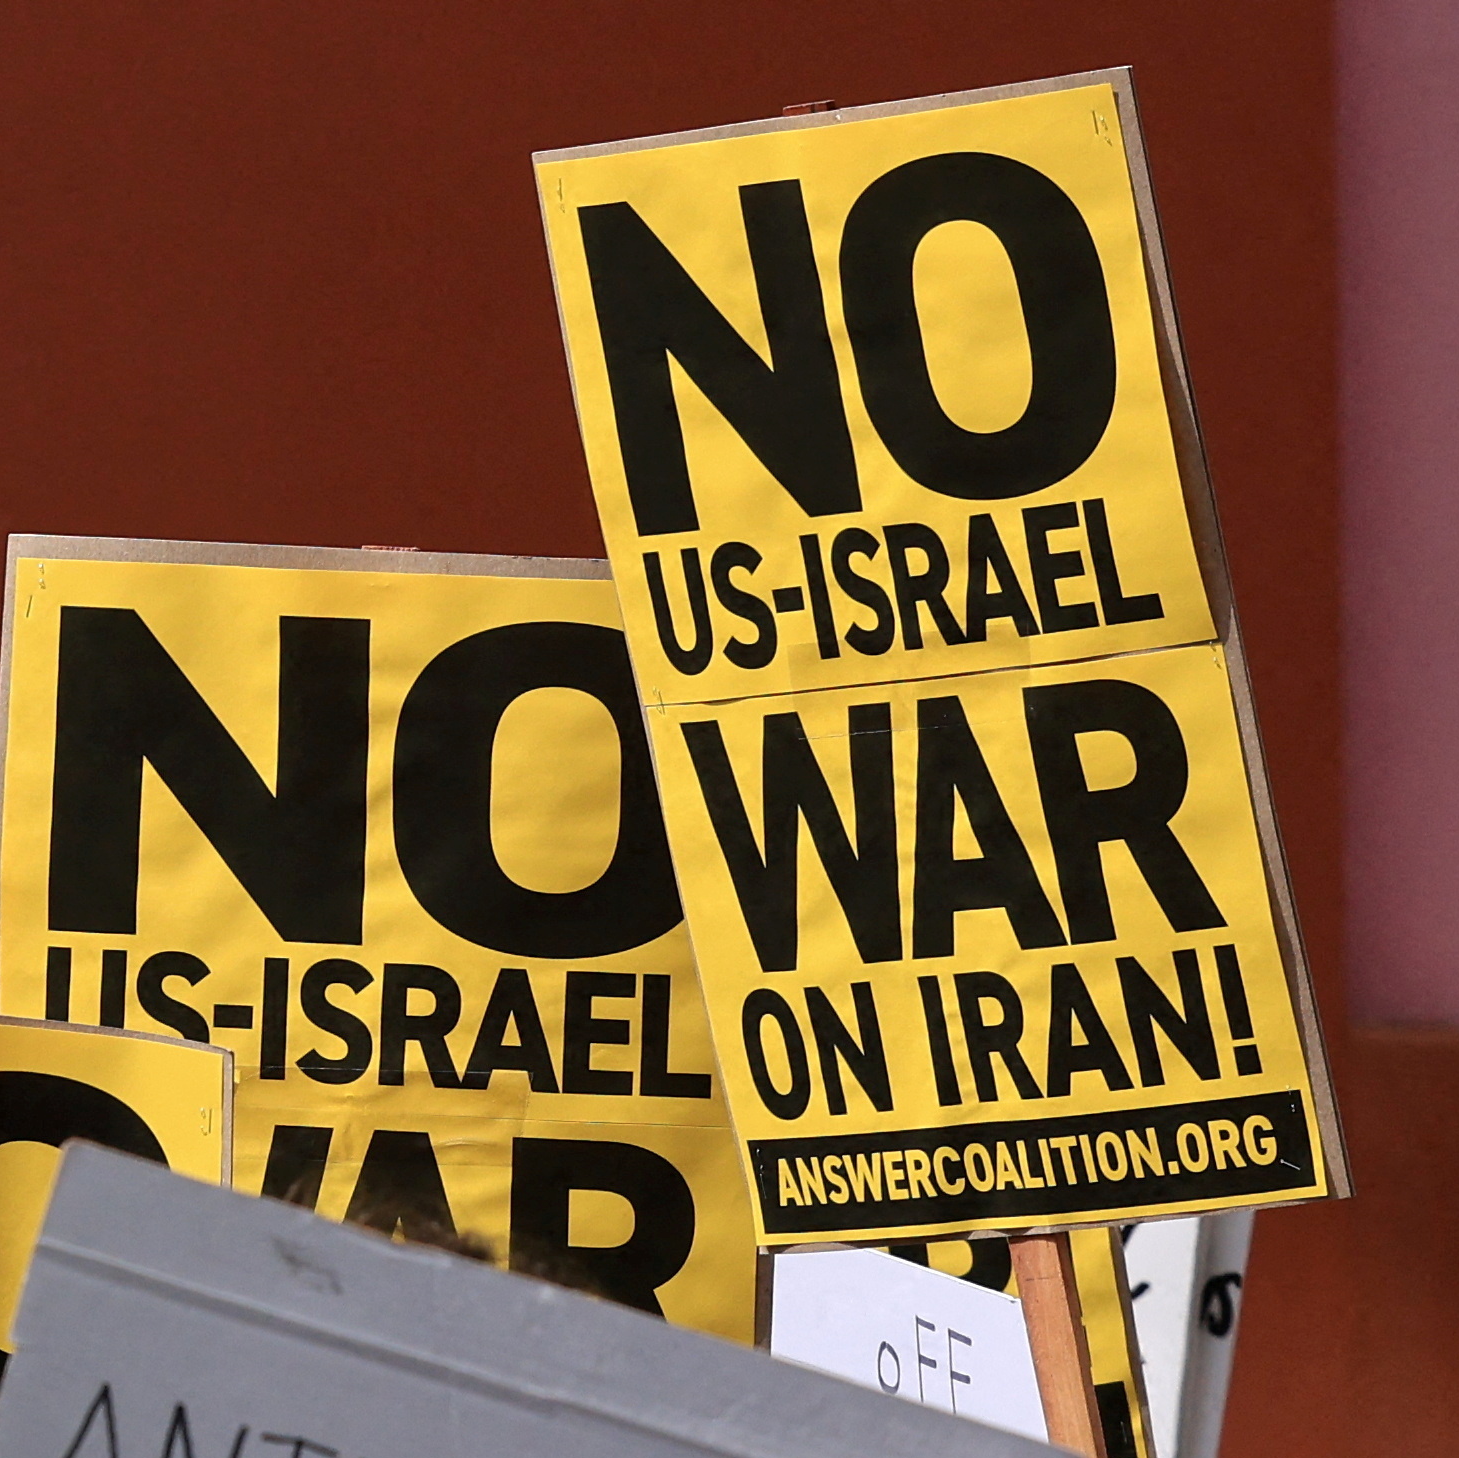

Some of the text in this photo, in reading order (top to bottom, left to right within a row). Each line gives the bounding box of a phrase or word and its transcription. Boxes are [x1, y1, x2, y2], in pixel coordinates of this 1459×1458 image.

[577, 151, 1117, 537] NO
[642, 498, 1165, 676] US-ISRAEL
[47, 604, 684, 959] NO
[680, 679, 1229, 973] WAR
[742, 944, 1263, 1121] ON IRAN!
[776, 1113, 1278, 1207] ANSWERCOALITION.ORG
